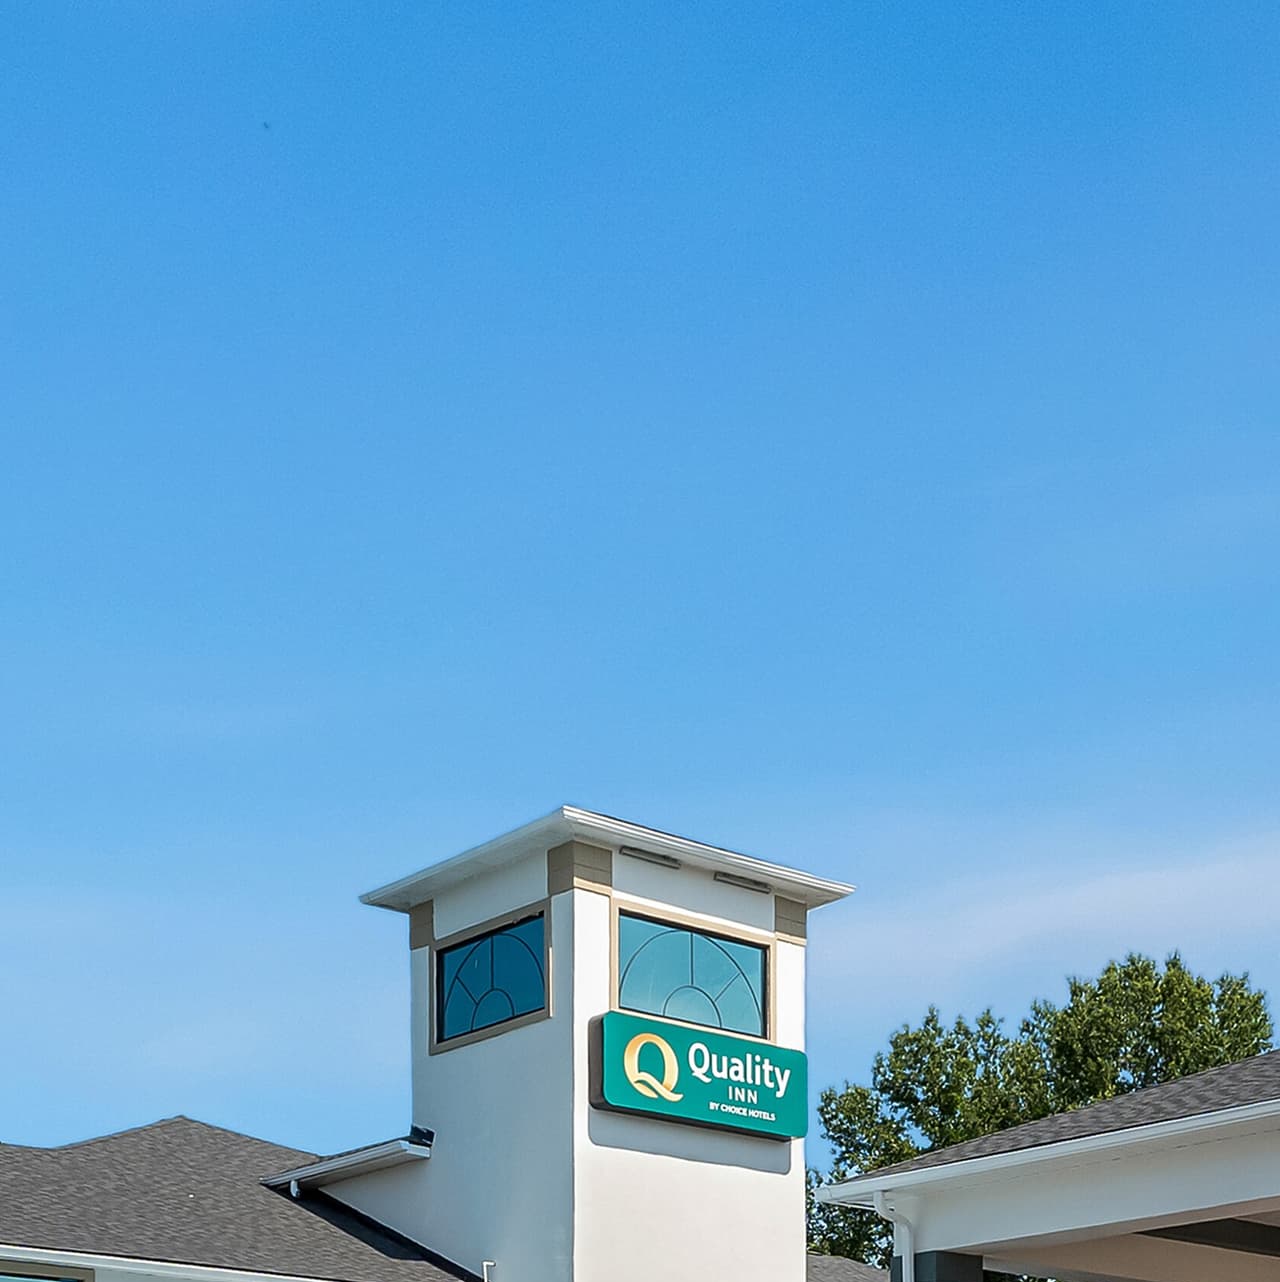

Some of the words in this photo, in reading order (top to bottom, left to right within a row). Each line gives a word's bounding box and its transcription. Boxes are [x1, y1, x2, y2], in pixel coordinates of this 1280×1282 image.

[623, 1032, 684, 1103] Q
[688, 1042, 791, 1098] Quality
[709, 1101, 720, 1111] BY
[720, 1103, 748, 1117] CHOICE
[748, 1108, 776, 1121] HOTELS
[728, 1085, 758, 1105] INN
